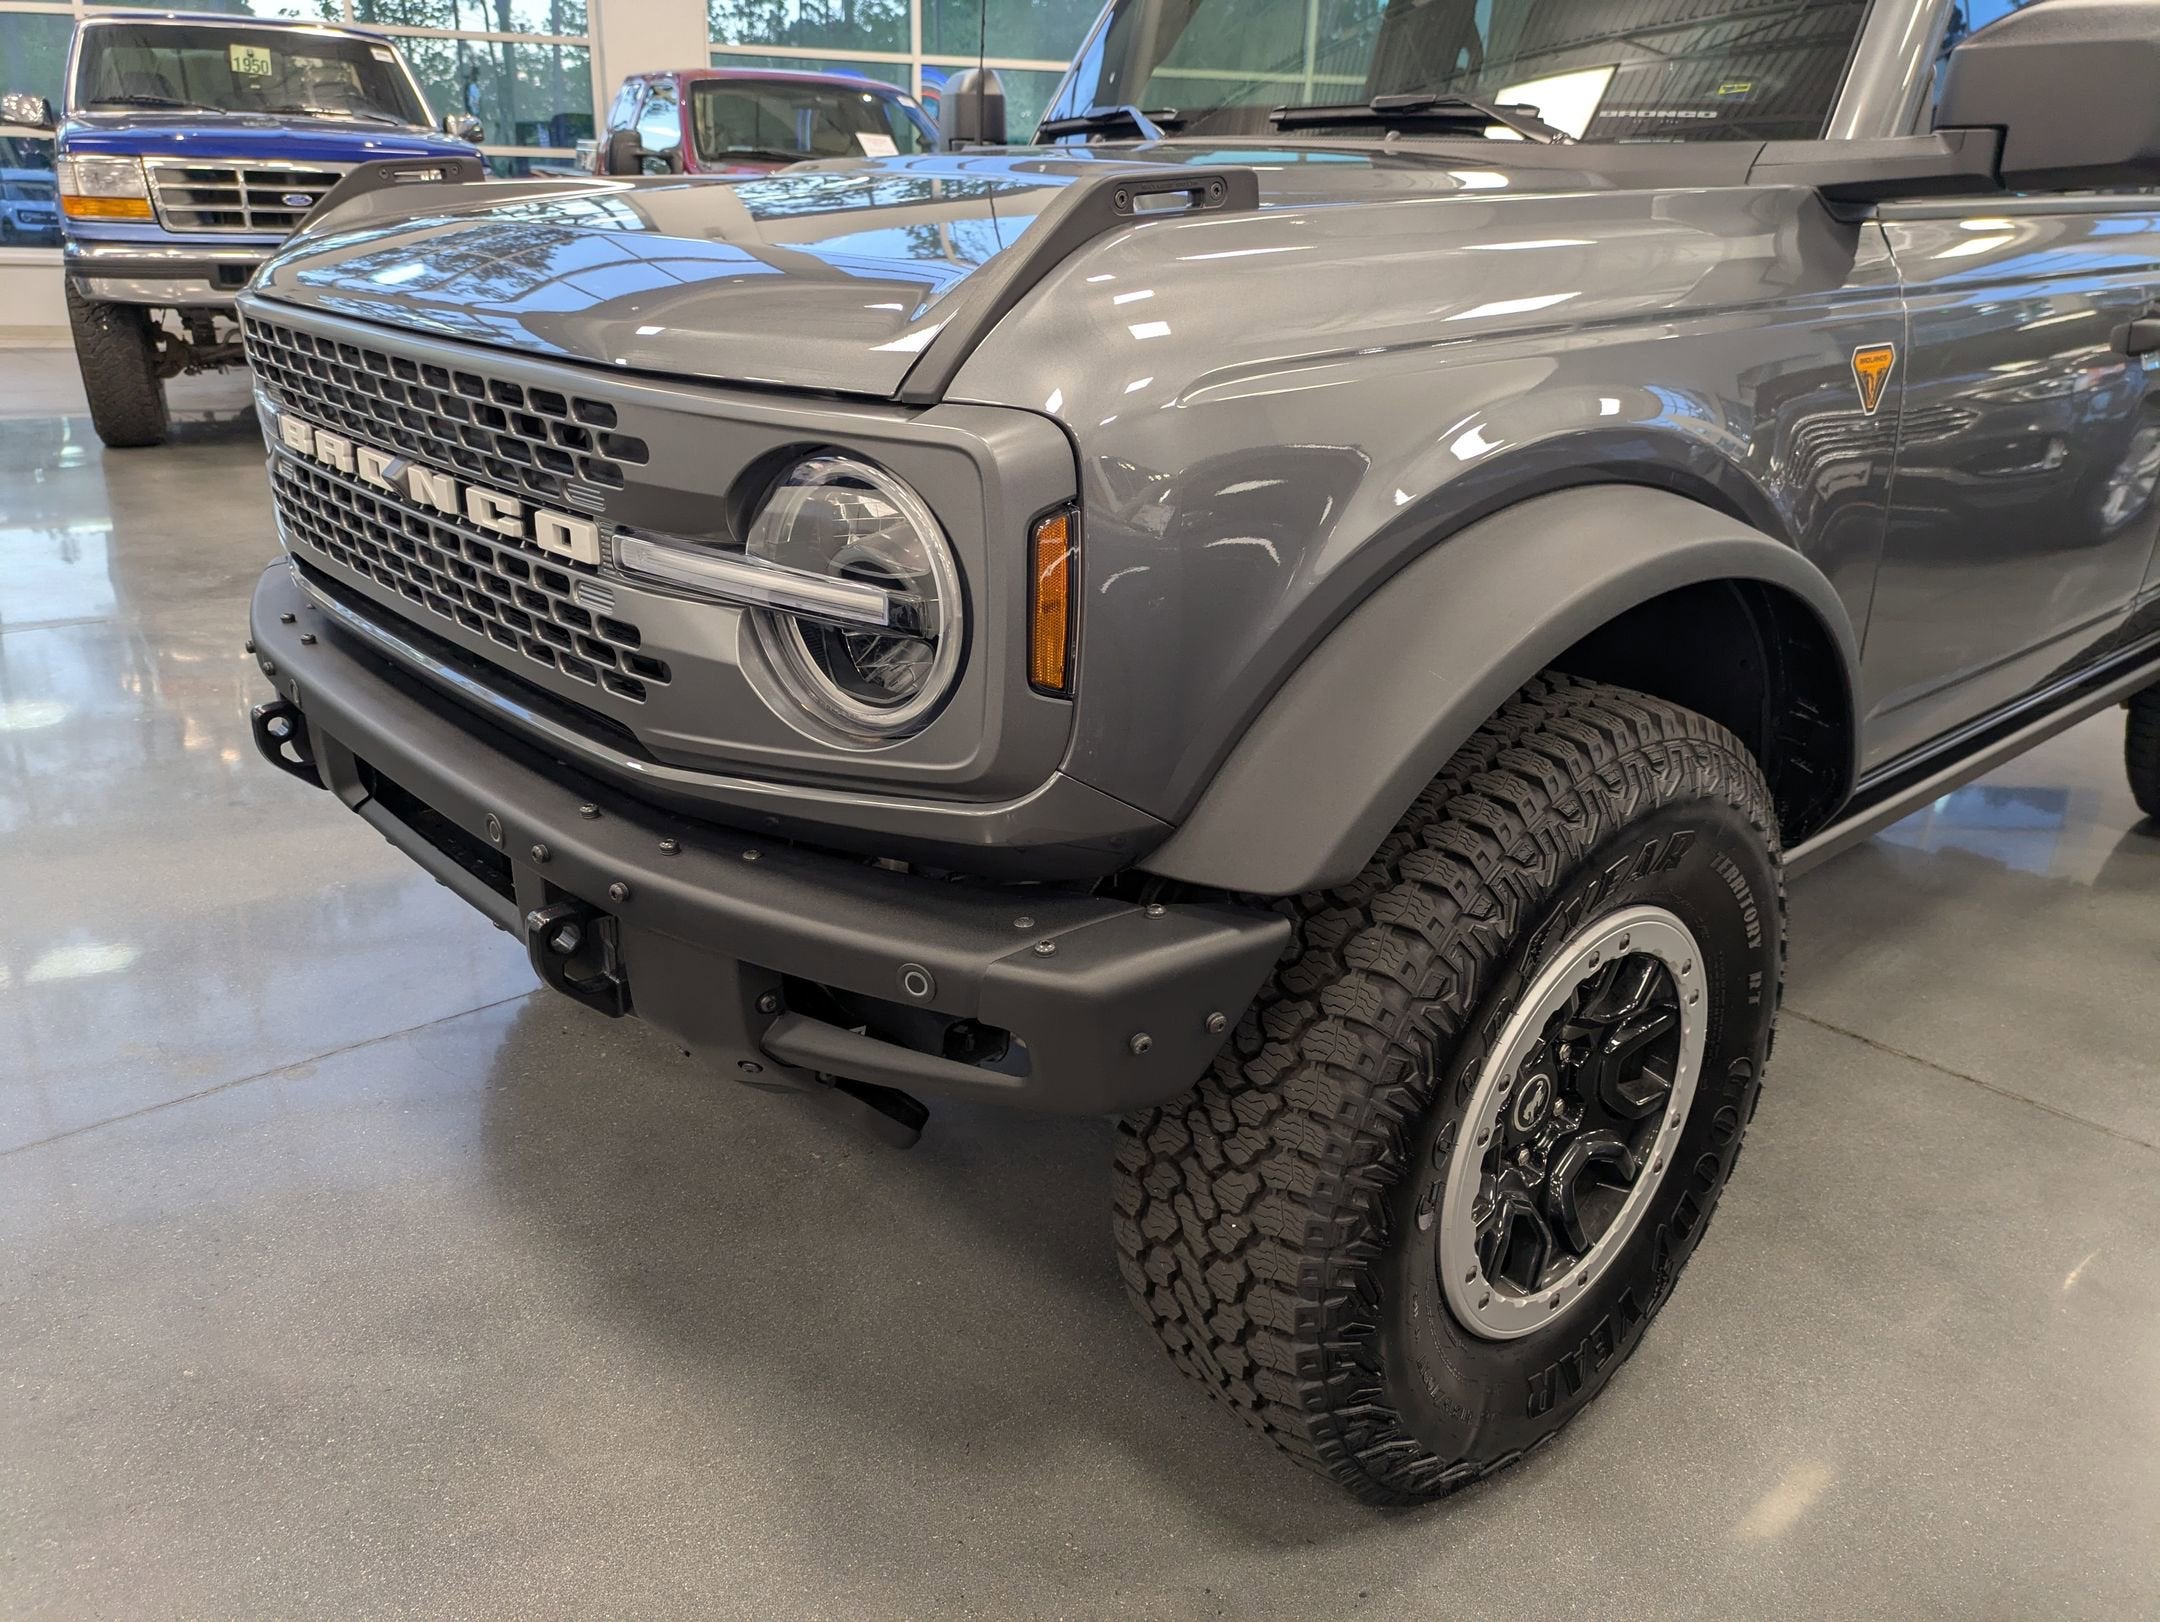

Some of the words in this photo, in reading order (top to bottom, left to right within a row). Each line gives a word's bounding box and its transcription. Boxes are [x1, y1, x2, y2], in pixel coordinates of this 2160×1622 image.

[233, 56, 269, 74] 1950
[280, 414, 601, 566] BRONCO
[1710, 851, 1762, 949] TERRITORY
[1748, 970, 1763, 1006] RT
[1527, 1056, 1754, 1420] GOODYEAR
